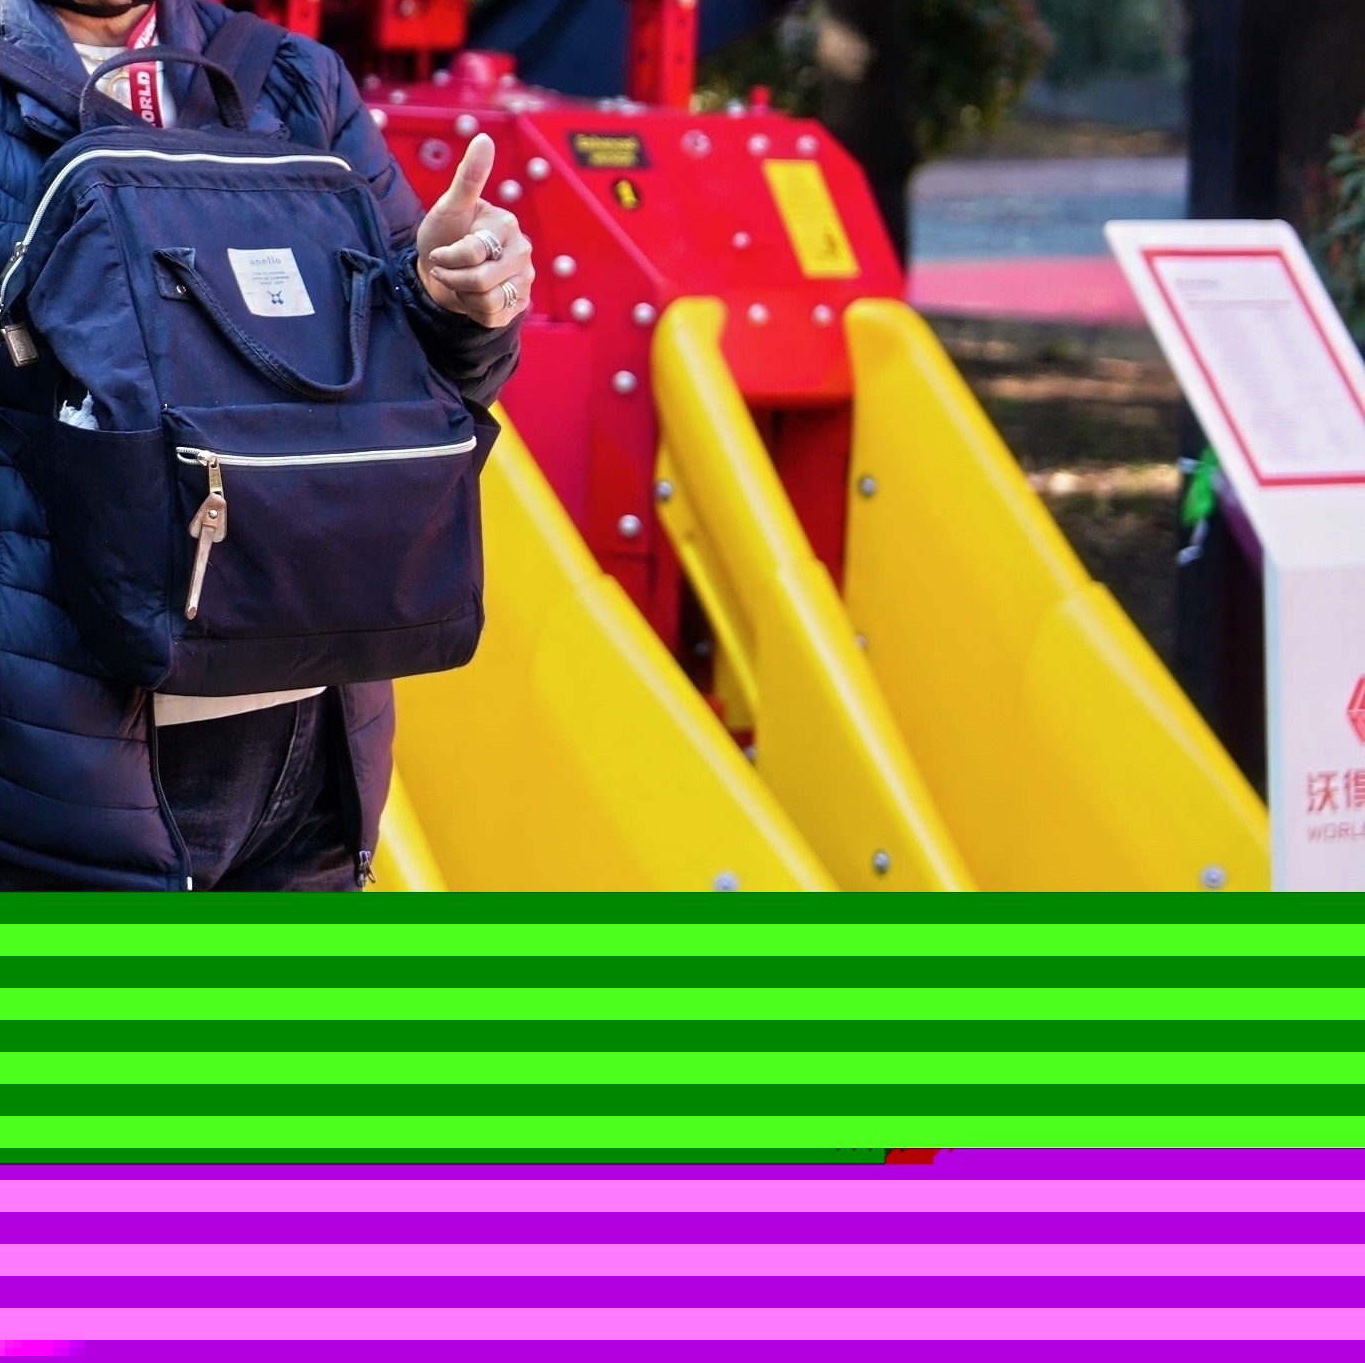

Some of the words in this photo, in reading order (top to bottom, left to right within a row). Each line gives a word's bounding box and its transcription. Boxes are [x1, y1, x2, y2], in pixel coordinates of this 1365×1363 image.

[137, 71, 156, 124] ORLD
[250, 256, 282, 266] anello
[1308, 821, 1365, 842] WORL
